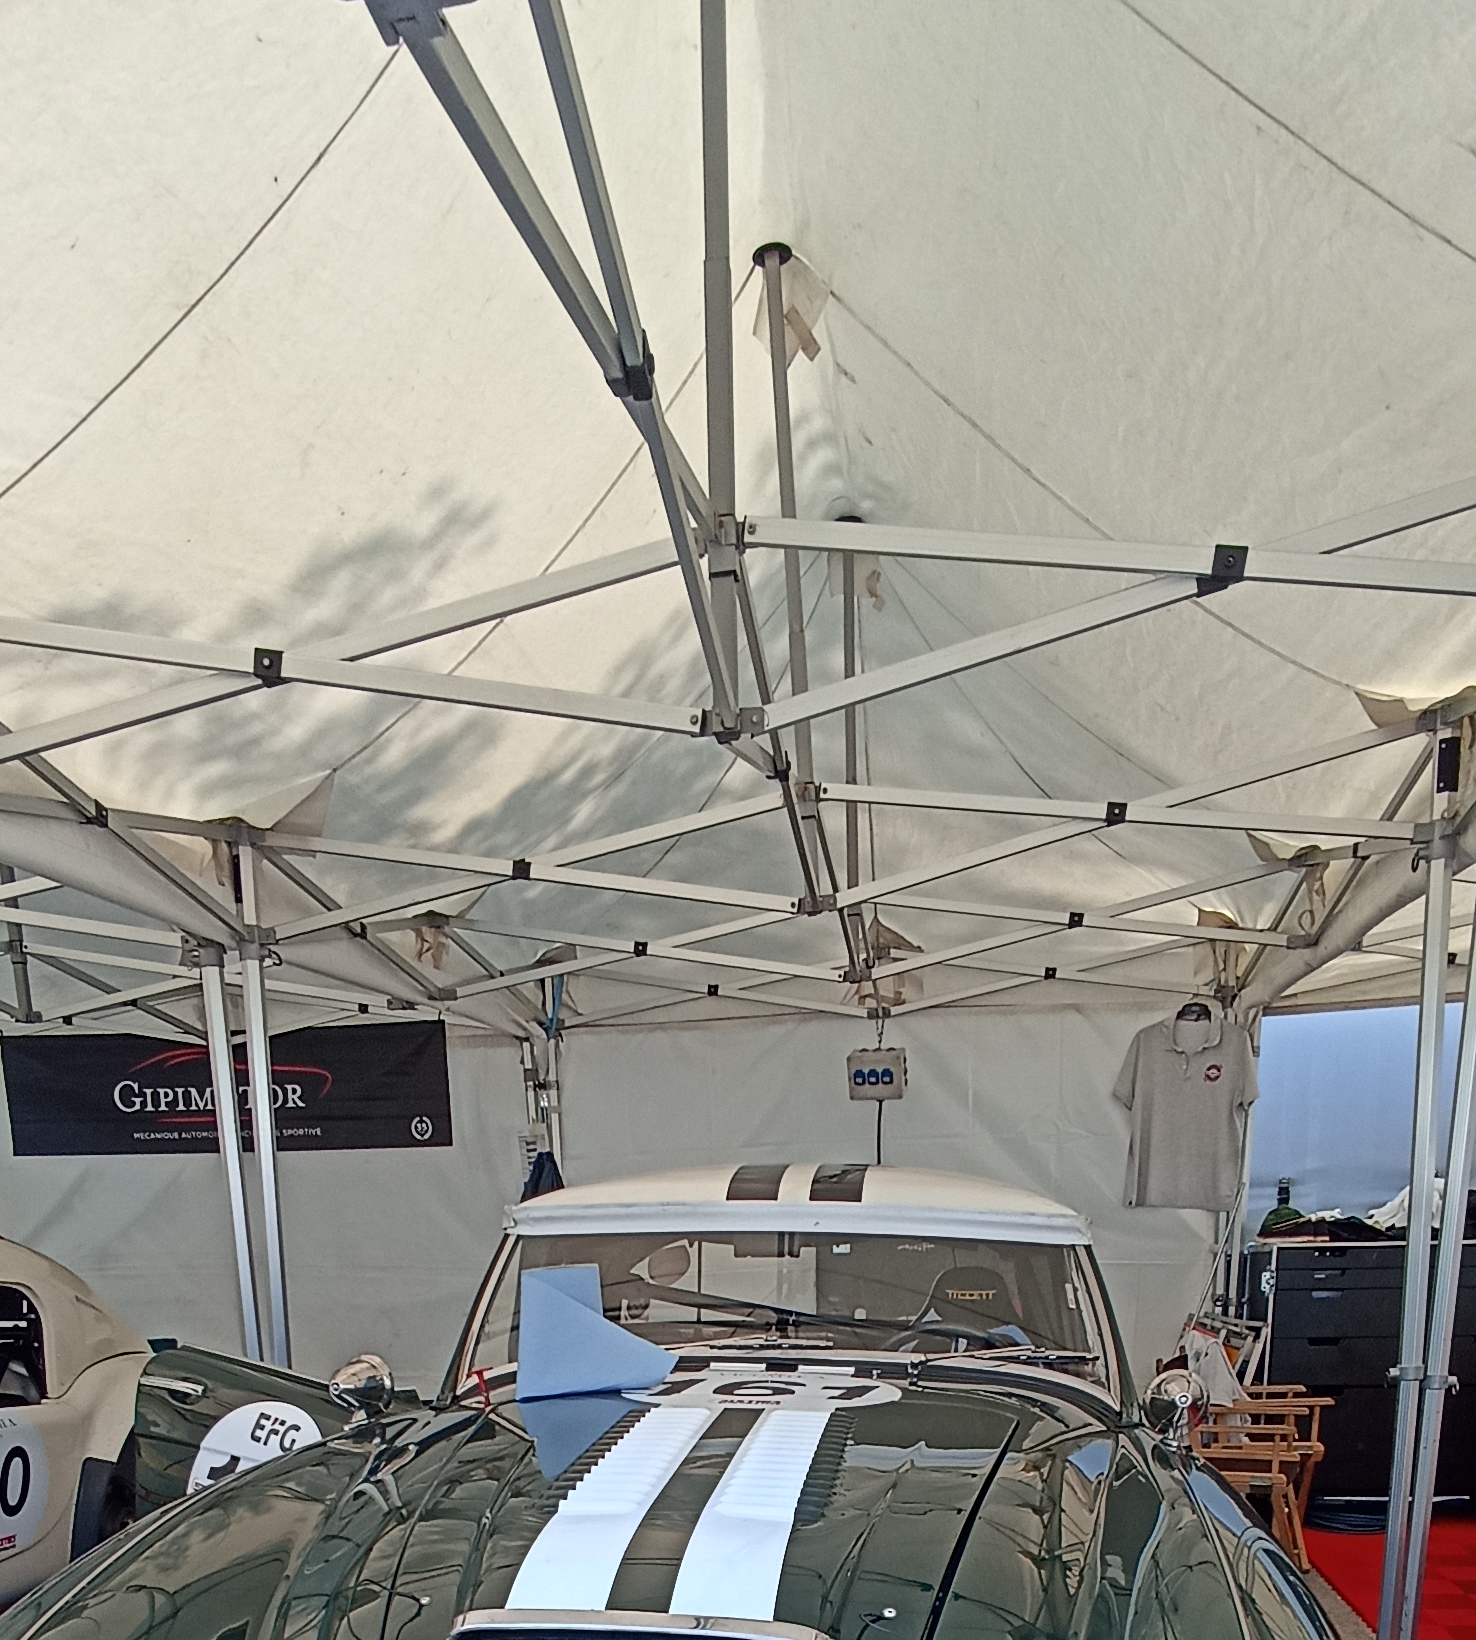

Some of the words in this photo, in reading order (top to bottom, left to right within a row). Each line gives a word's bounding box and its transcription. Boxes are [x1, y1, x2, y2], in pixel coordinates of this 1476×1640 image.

[113, 1080, 306, 1113] GIPIMTOR
[282, 1127, 321, 1137] SPORTIVE
[250, 1412, 301, 1453] EFG
